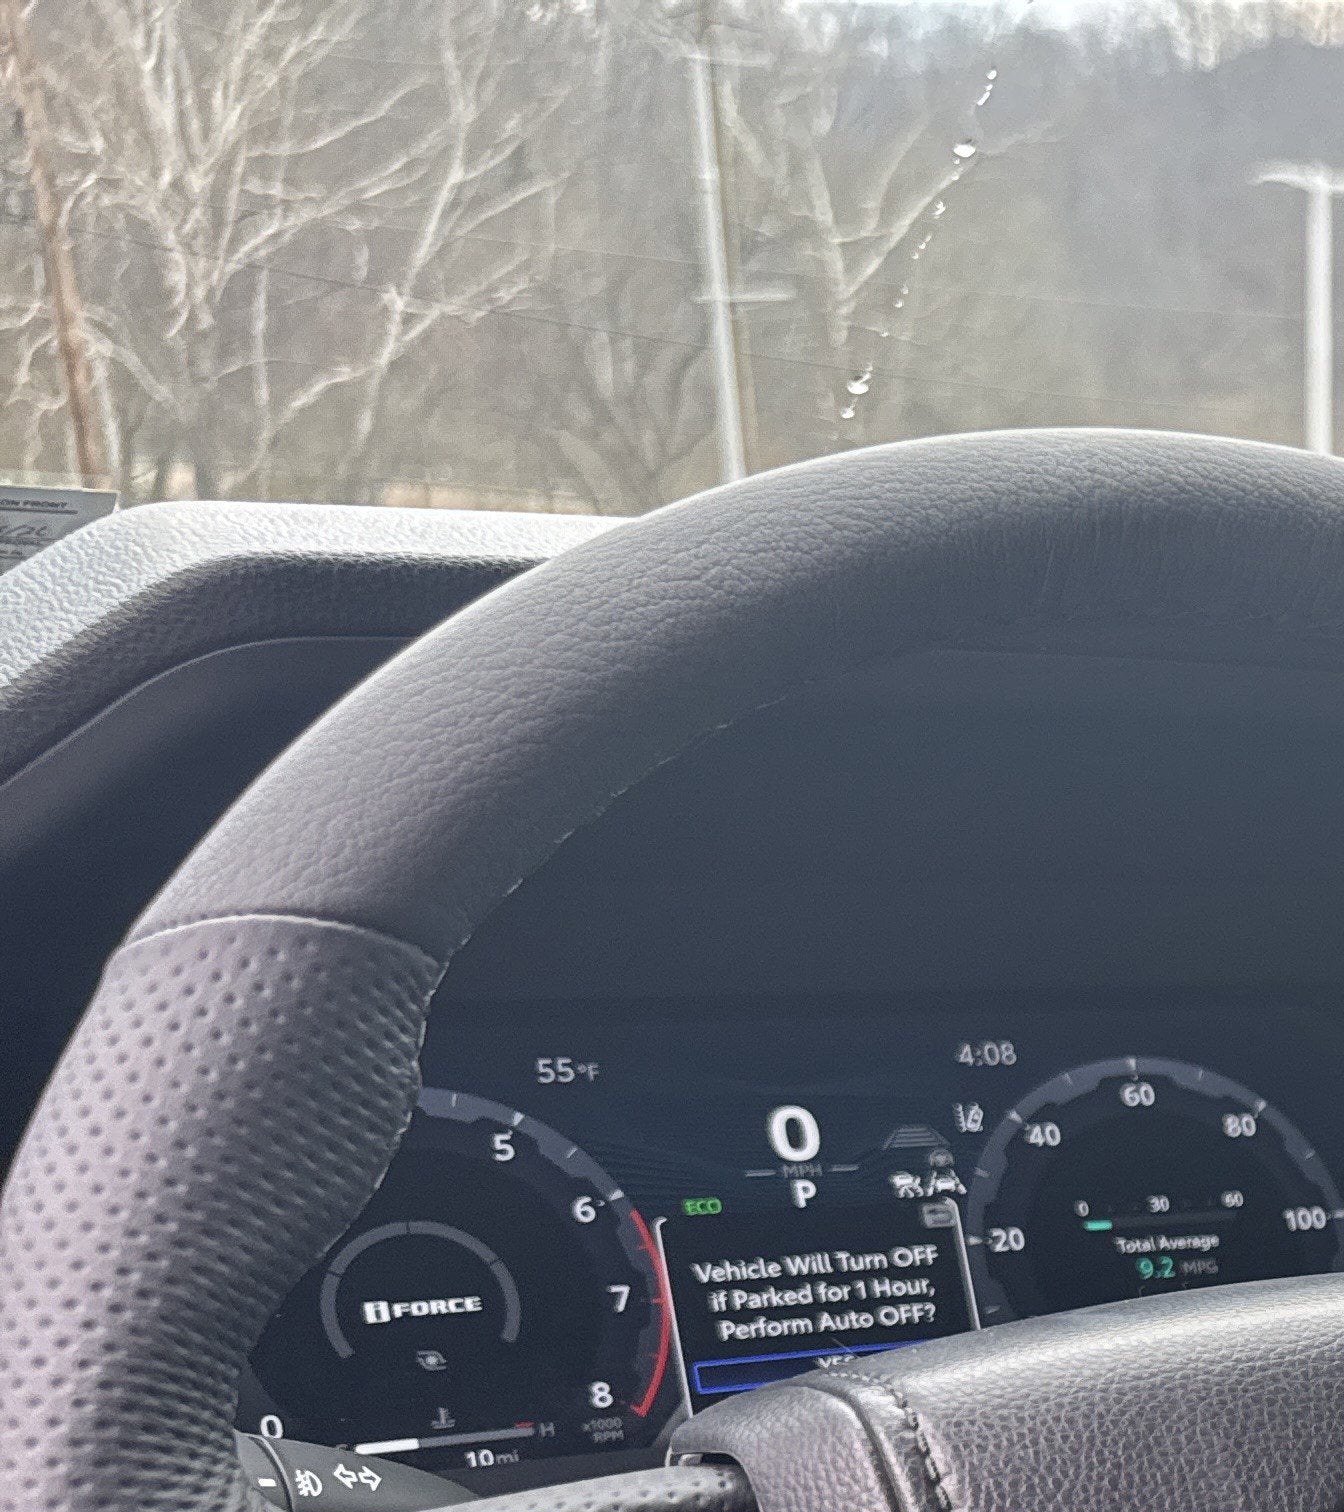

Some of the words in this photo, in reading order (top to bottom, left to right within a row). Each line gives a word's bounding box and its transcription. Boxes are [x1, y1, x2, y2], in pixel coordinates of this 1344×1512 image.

[956, 1041, 1017, 1067] 4:08
[1120, 1083, 1156, 1107] 60
[768, 1105, 820, 1162] 0
[1026, 1122, 1061, 1147] 40
[1222, 1113, 1258, 1138] 80
[492, 1133, 515, 1163] 5
[782, 1163, 823, 1178] MPH
[791, 1179, 816, 1208] P
[572, 1196, 597, 1223] 6
[683, 1197, 722, 1216] ECO
[1283, 1206, 1327, 1231] 100
[990, 1227, 1025, 1252] 20
[1114, 1236, 1155, 1253] Total
[1157, 1234, 1219, 1252] Average
[691, 1257, 781, 1283] Vehicle
[782, 1252, 833, 1276] Will
[834, 1251, 887, 1273] Turn
[889, 1244, 938, 1268] OFF
[1136, 1256, 1176, 1280] 9.2
[1181, 1257, 1219, 1275] MPG
[606, 1285, 631, 1312] 7
[708, 1289, 728, 1312] if
[729, 1285, 813, 1311] Parked
[815, 1281, 850, 1302] for
[852, 1280, 867, 1300] 1
[870, 1276, 935, 1299] Hour,
[717, 1315, 813, 1342] Perform
[817, 1310, 874, 1332] Auto
[875, 1302, 936, 1326] OFF?
[588, 1381, 614, 1409] 8
[260, 1414, 284, 1439] 0
[540, 1422, 555, 1438] H
